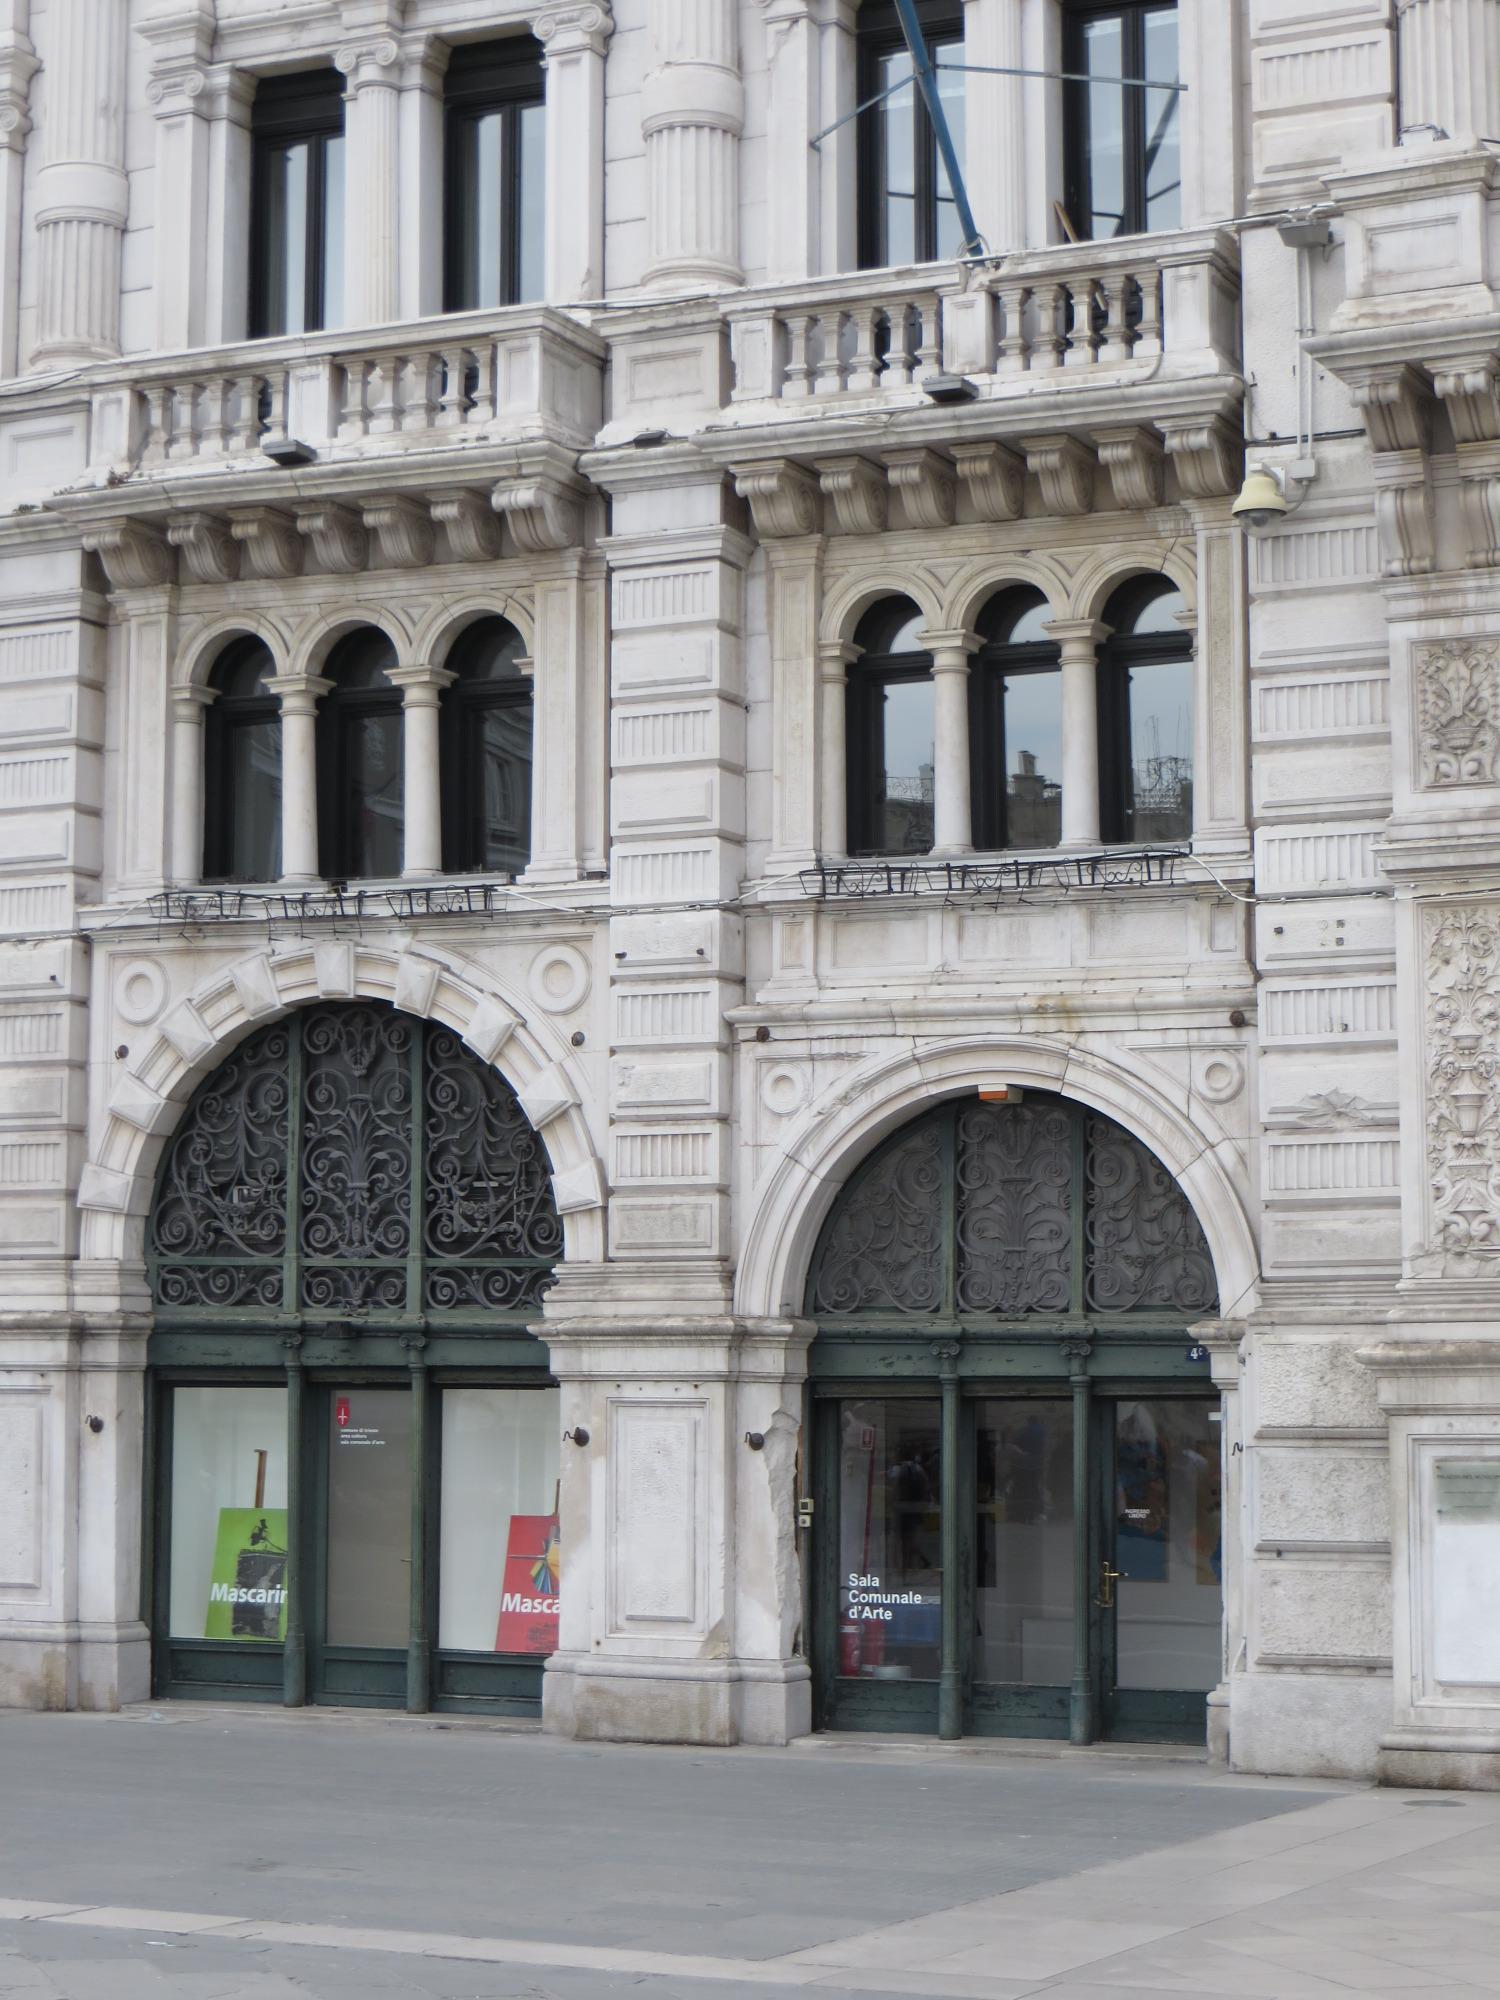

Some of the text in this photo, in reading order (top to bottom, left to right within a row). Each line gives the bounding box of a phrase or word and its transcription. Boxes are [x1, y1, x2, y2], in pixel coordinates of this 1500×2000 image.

[848, 1573, 880, 1587] Sala
[501, 1592, 560, 1614] Masca
[848, 1590, 922, 1604] Comunale
[848, 1605, 893, 1620] d'Arte
